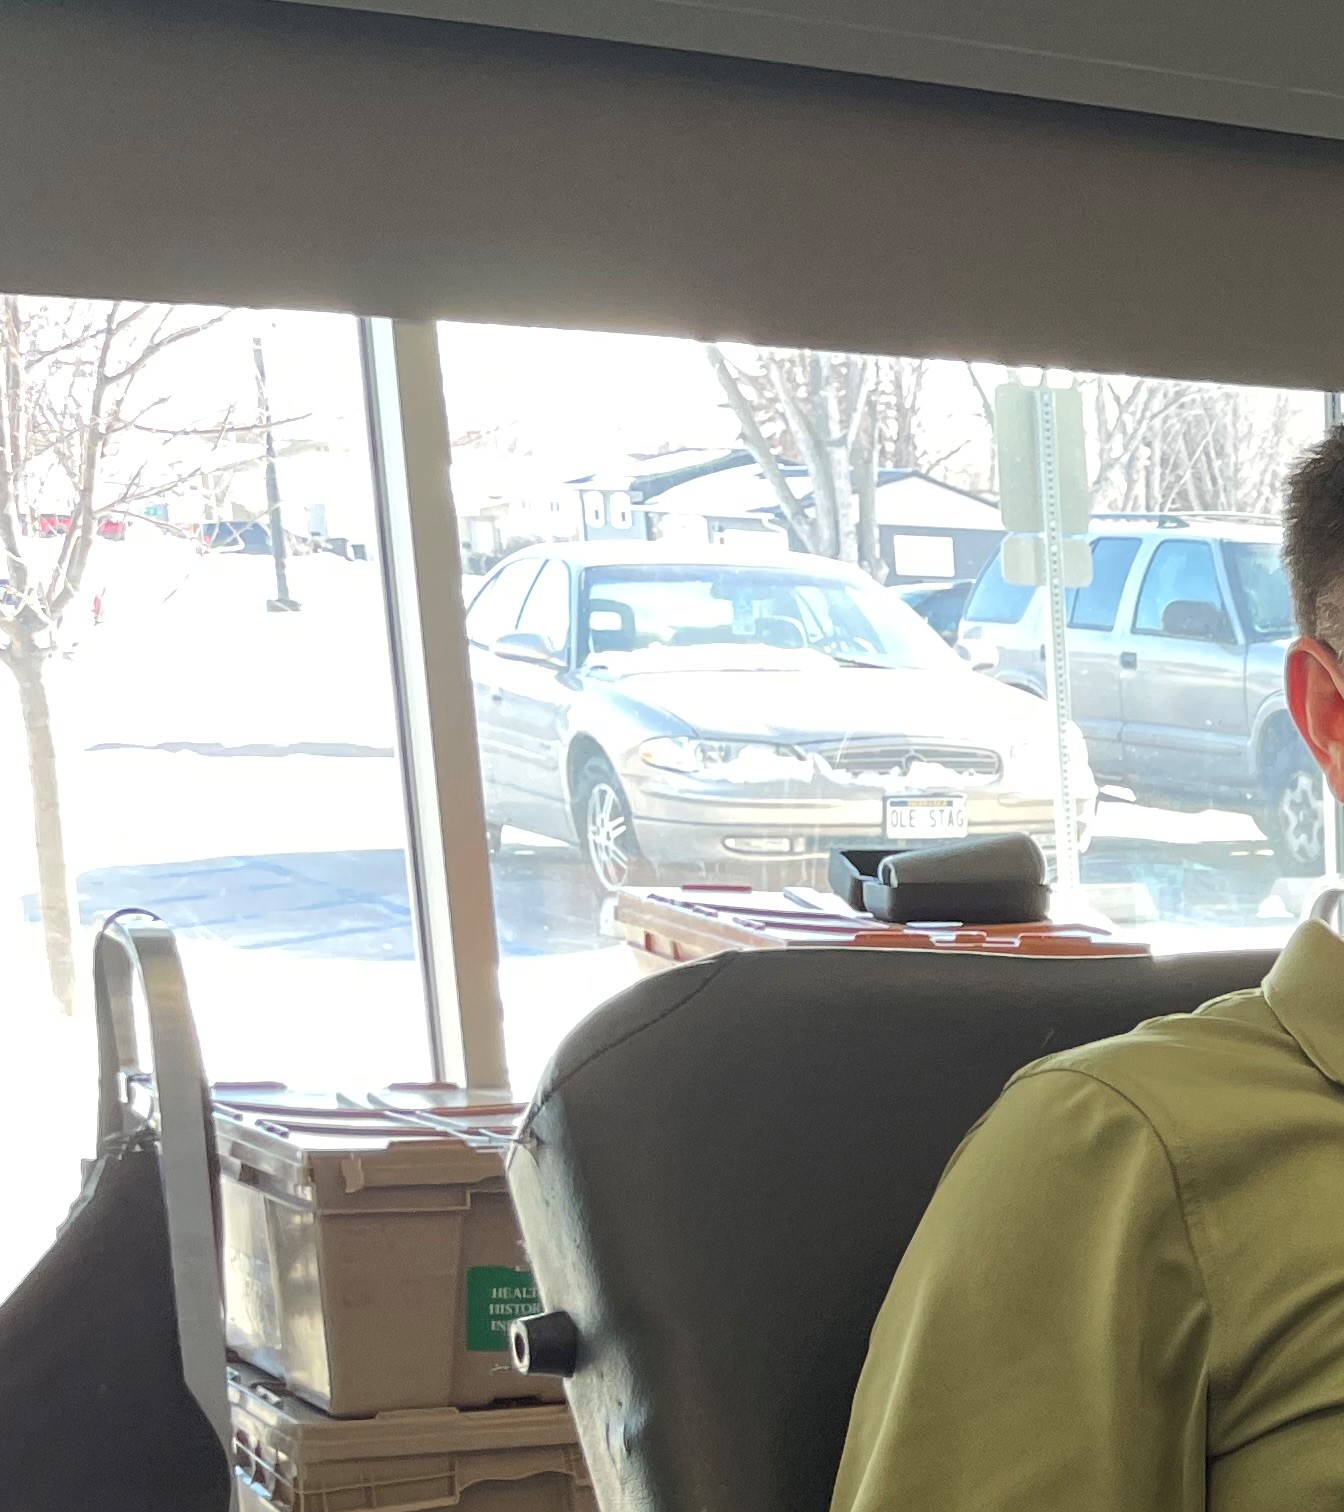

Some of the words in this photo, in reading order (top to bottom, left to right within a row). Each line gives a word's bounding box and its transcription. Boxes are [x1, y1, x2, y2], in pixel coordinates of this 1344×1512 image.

[891, 809, 916, 828] OLE
[929, 809, 964, 828] STAG
[491, 1287, 538, 1299] HEALT
[489, 1303, 540, 1315] HISTOR
